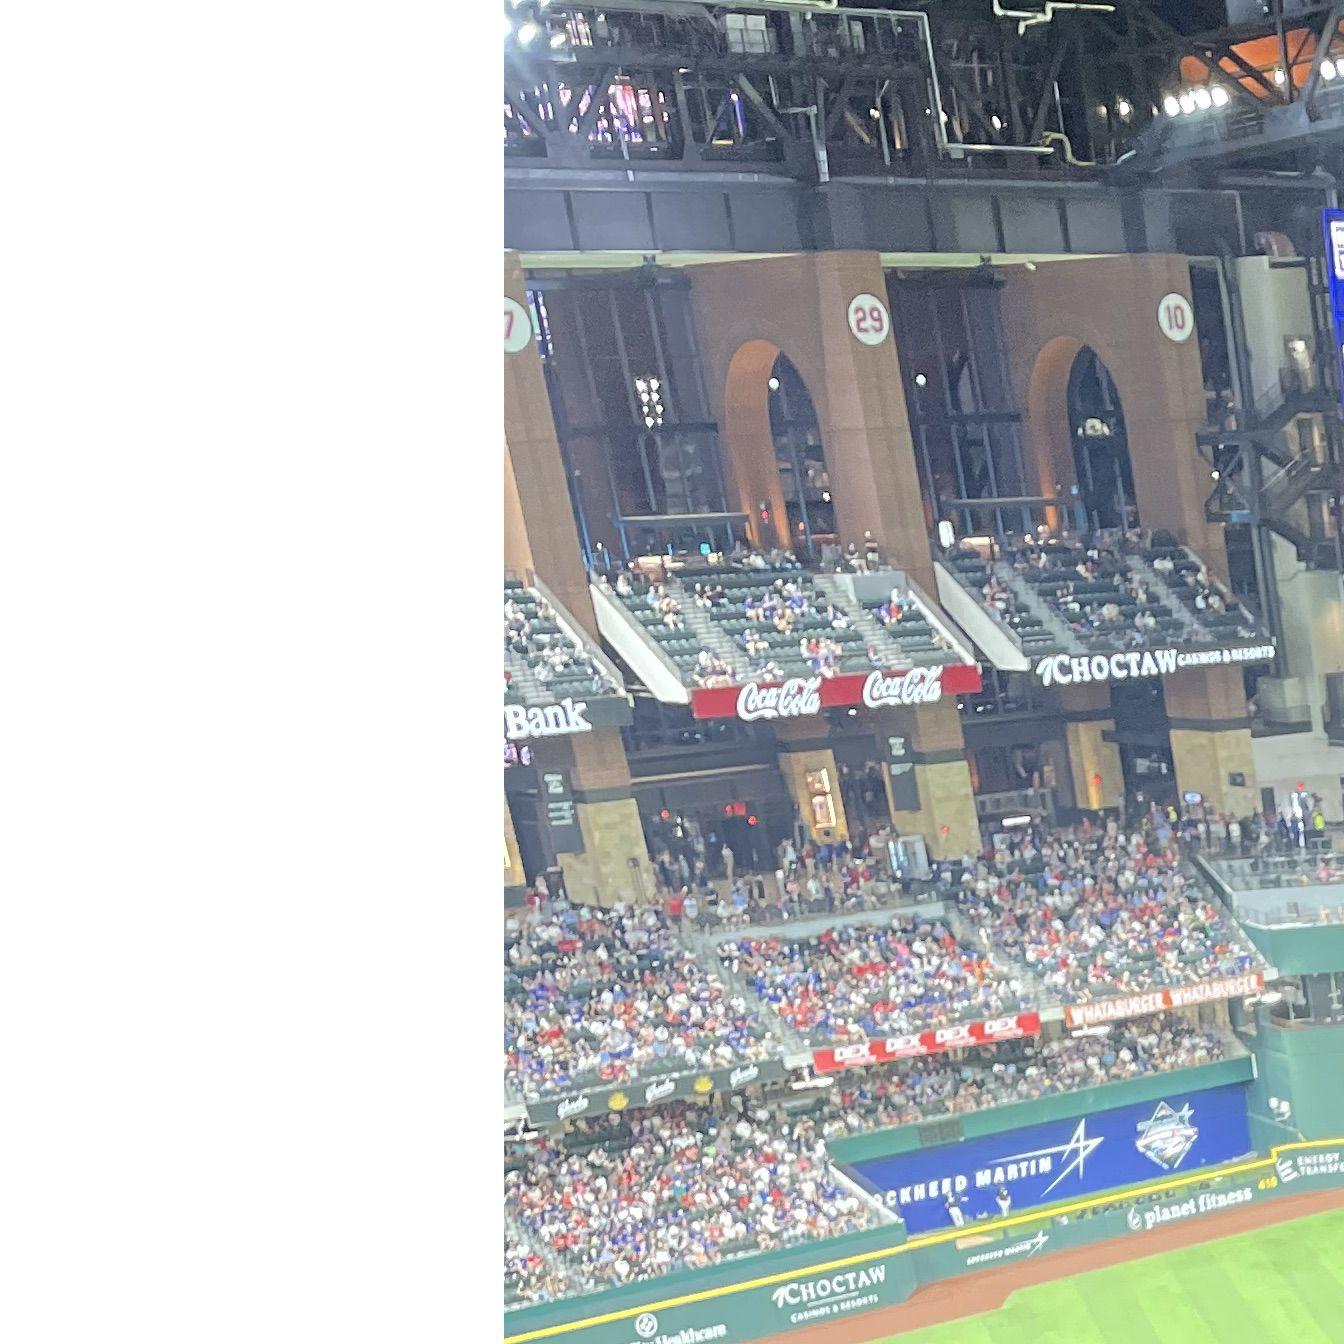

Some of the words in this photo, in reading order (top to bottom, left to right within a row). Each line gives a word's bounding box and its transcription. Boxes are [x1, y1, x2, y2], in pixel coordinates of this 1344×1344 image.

[855, 305, 884, 335] 29
[1165, 304, 1187, 332] 10
[1053, 649, 1178, 685] CHOCTAW
[505, 697, 592, 741] Bank
[1170, 973, 1261, 1006] WHATABURGER
[984, 1014, 1019, 1034] DEX
[1069, 992, 1166, 1026] WHATABURGER
[885, 1034, 921, 1053] DEX
[936, 1023, 971, 1042] DEX
[834, 1043, 870, 1062] DEX
[1297, 1152, 1341, 1167] ENERGY
[874, 1174, 968, 1207] OCKHEED
[975, 1156, 1052, 1188] MARTIN
[1144, 1195, 1197, 1230] planet
[1198, 1186, 1254, 1214] fitness
[784, 1264, 886, 1306] CHOCTAW
